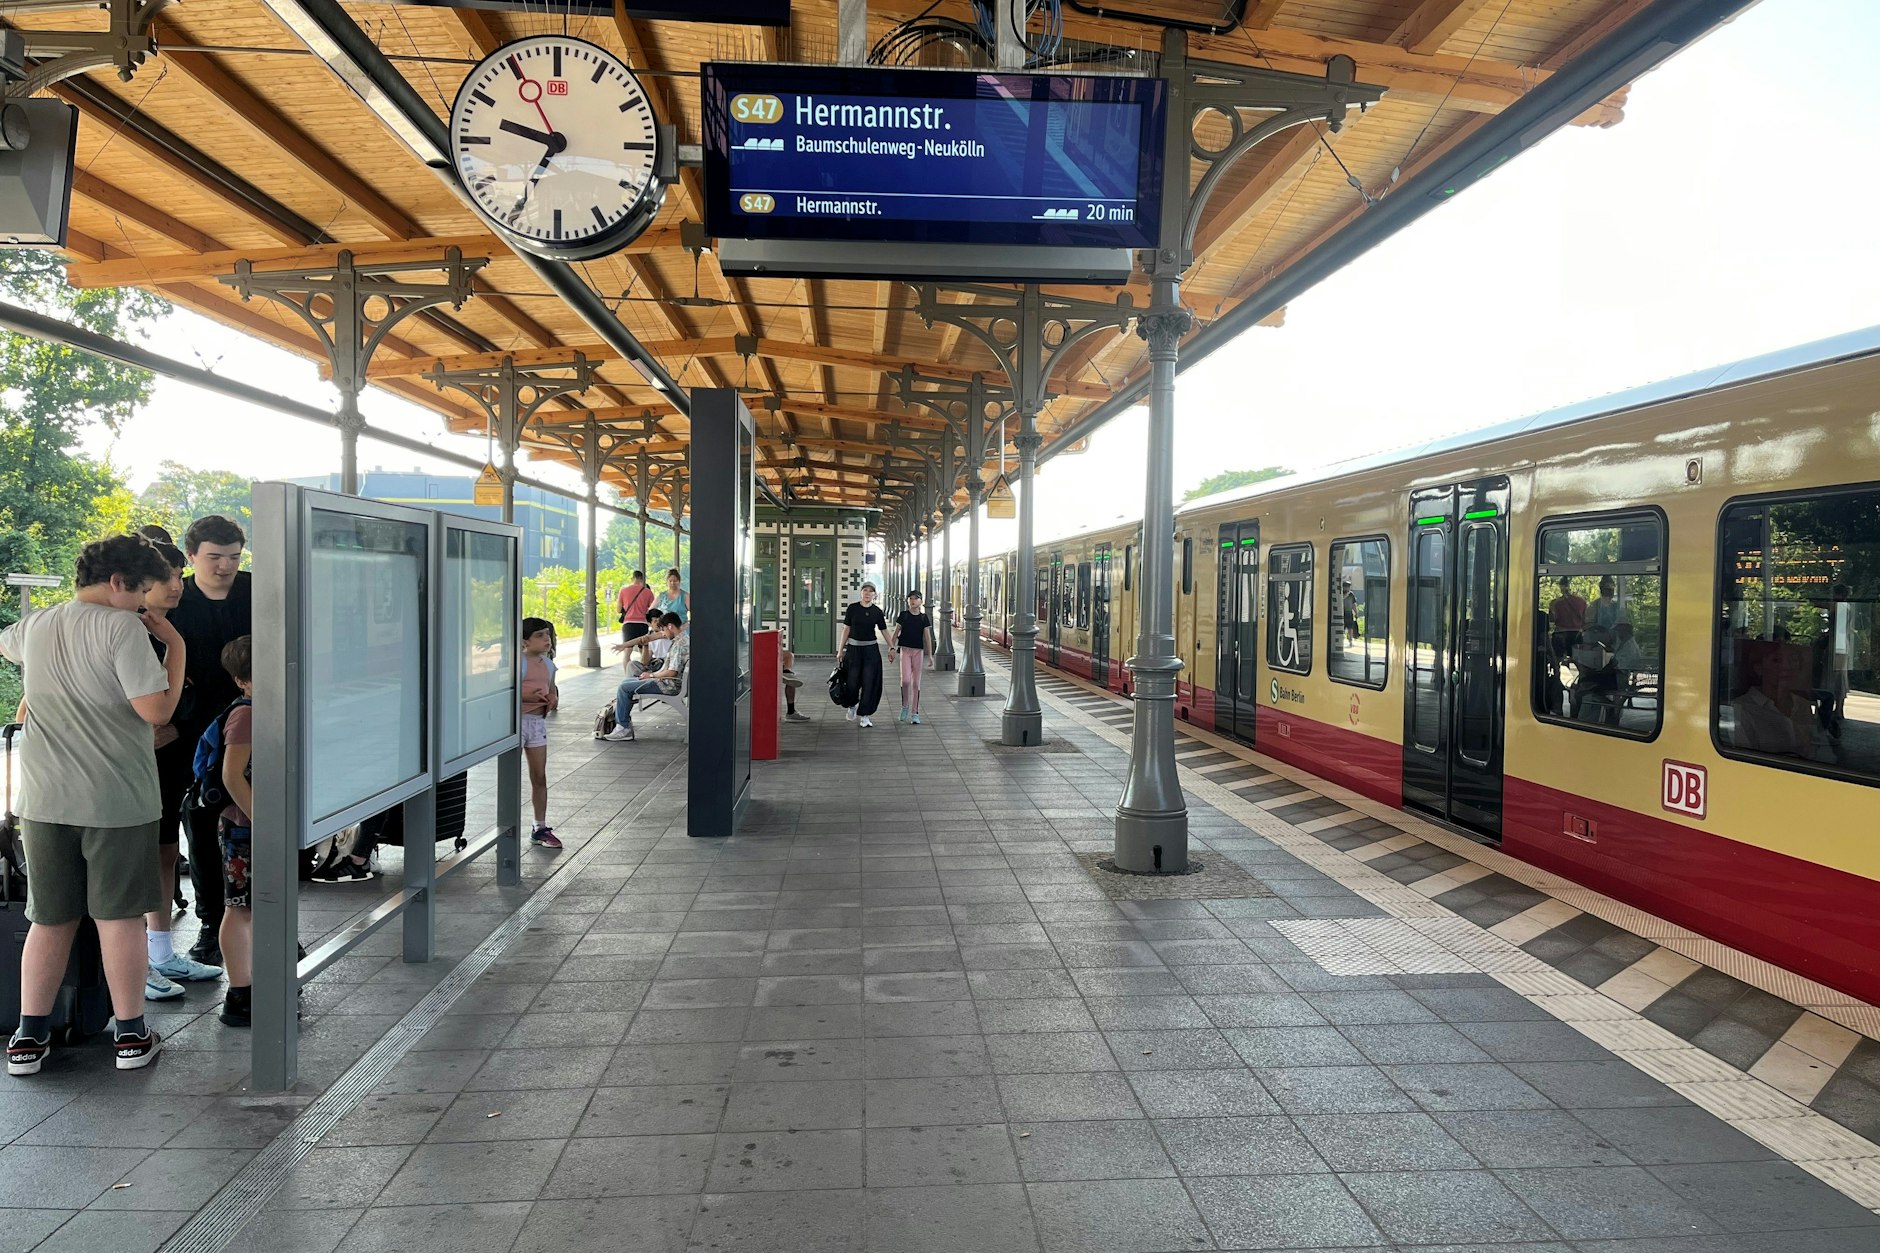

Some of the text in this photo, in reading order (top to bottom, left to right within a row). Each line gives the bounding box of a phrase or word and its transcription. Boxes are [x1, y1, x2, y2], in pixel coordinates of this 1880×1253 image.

[549, 83, 566, 93] DB
[736, 97, 777, 120] S47
[795, 95, 951, 130] Hermannstr.
[743, 196, 771, 211] S47
[796, 196, 882, 215] Hermannstr.
[1086, 204, 1134, 221] 20 min
[1271, 678, 1305, 704] S Bahn Berlin
[1667, 767, 1702, 810] DB
[11, 1053, 37, 1062] adidas
[117, 1048, 142, 1057] adidas
